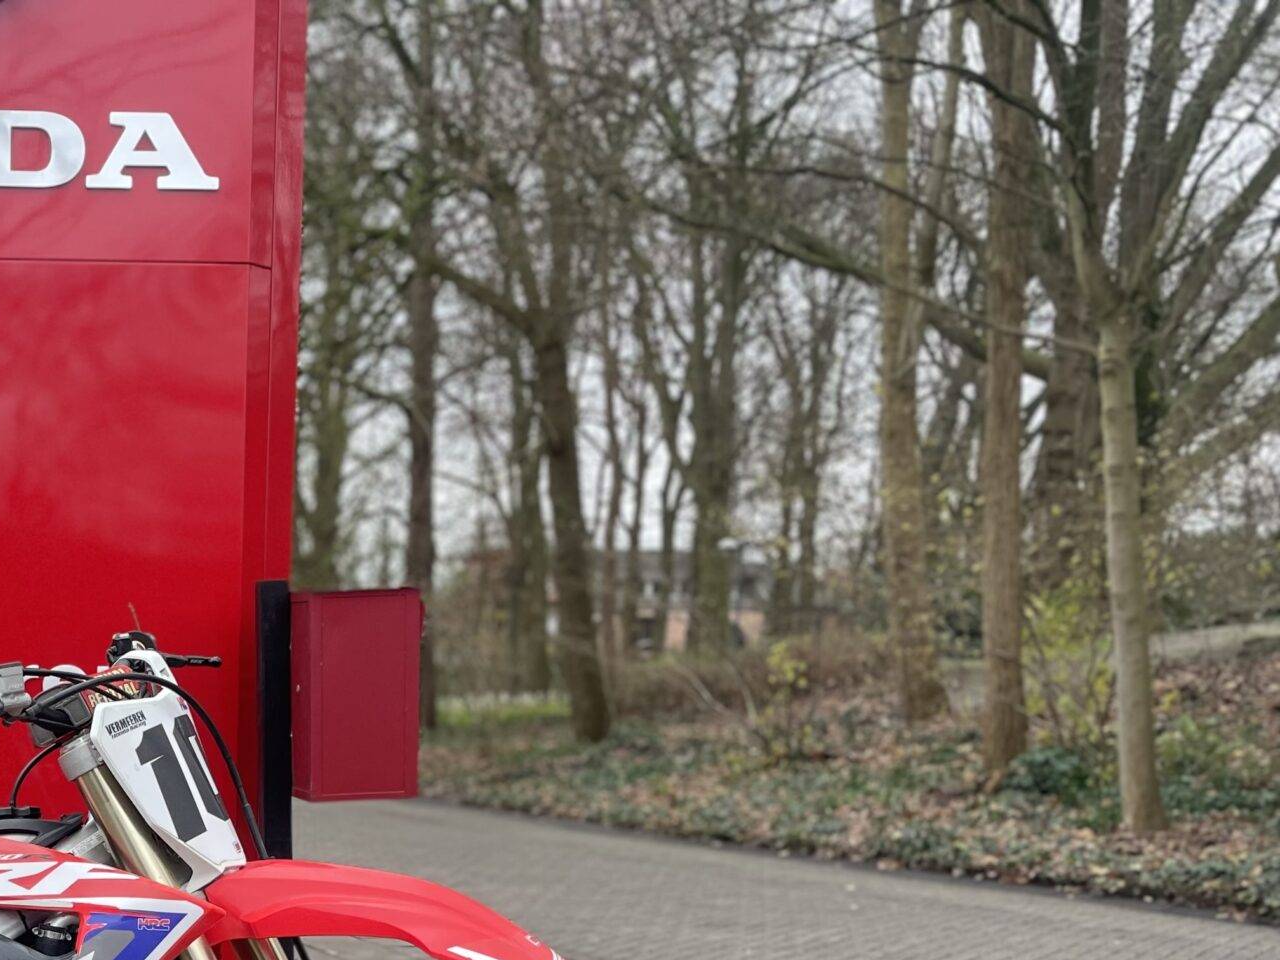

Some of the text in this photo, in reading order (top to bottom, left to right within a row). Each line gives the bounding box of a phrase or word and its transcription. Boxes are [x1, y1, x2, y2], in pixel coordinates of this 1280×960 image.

[105, 709, 147, 737] VERMEEREN
[134, 712, 230, 843] 10
[137, 917, 171, 931] HRC
